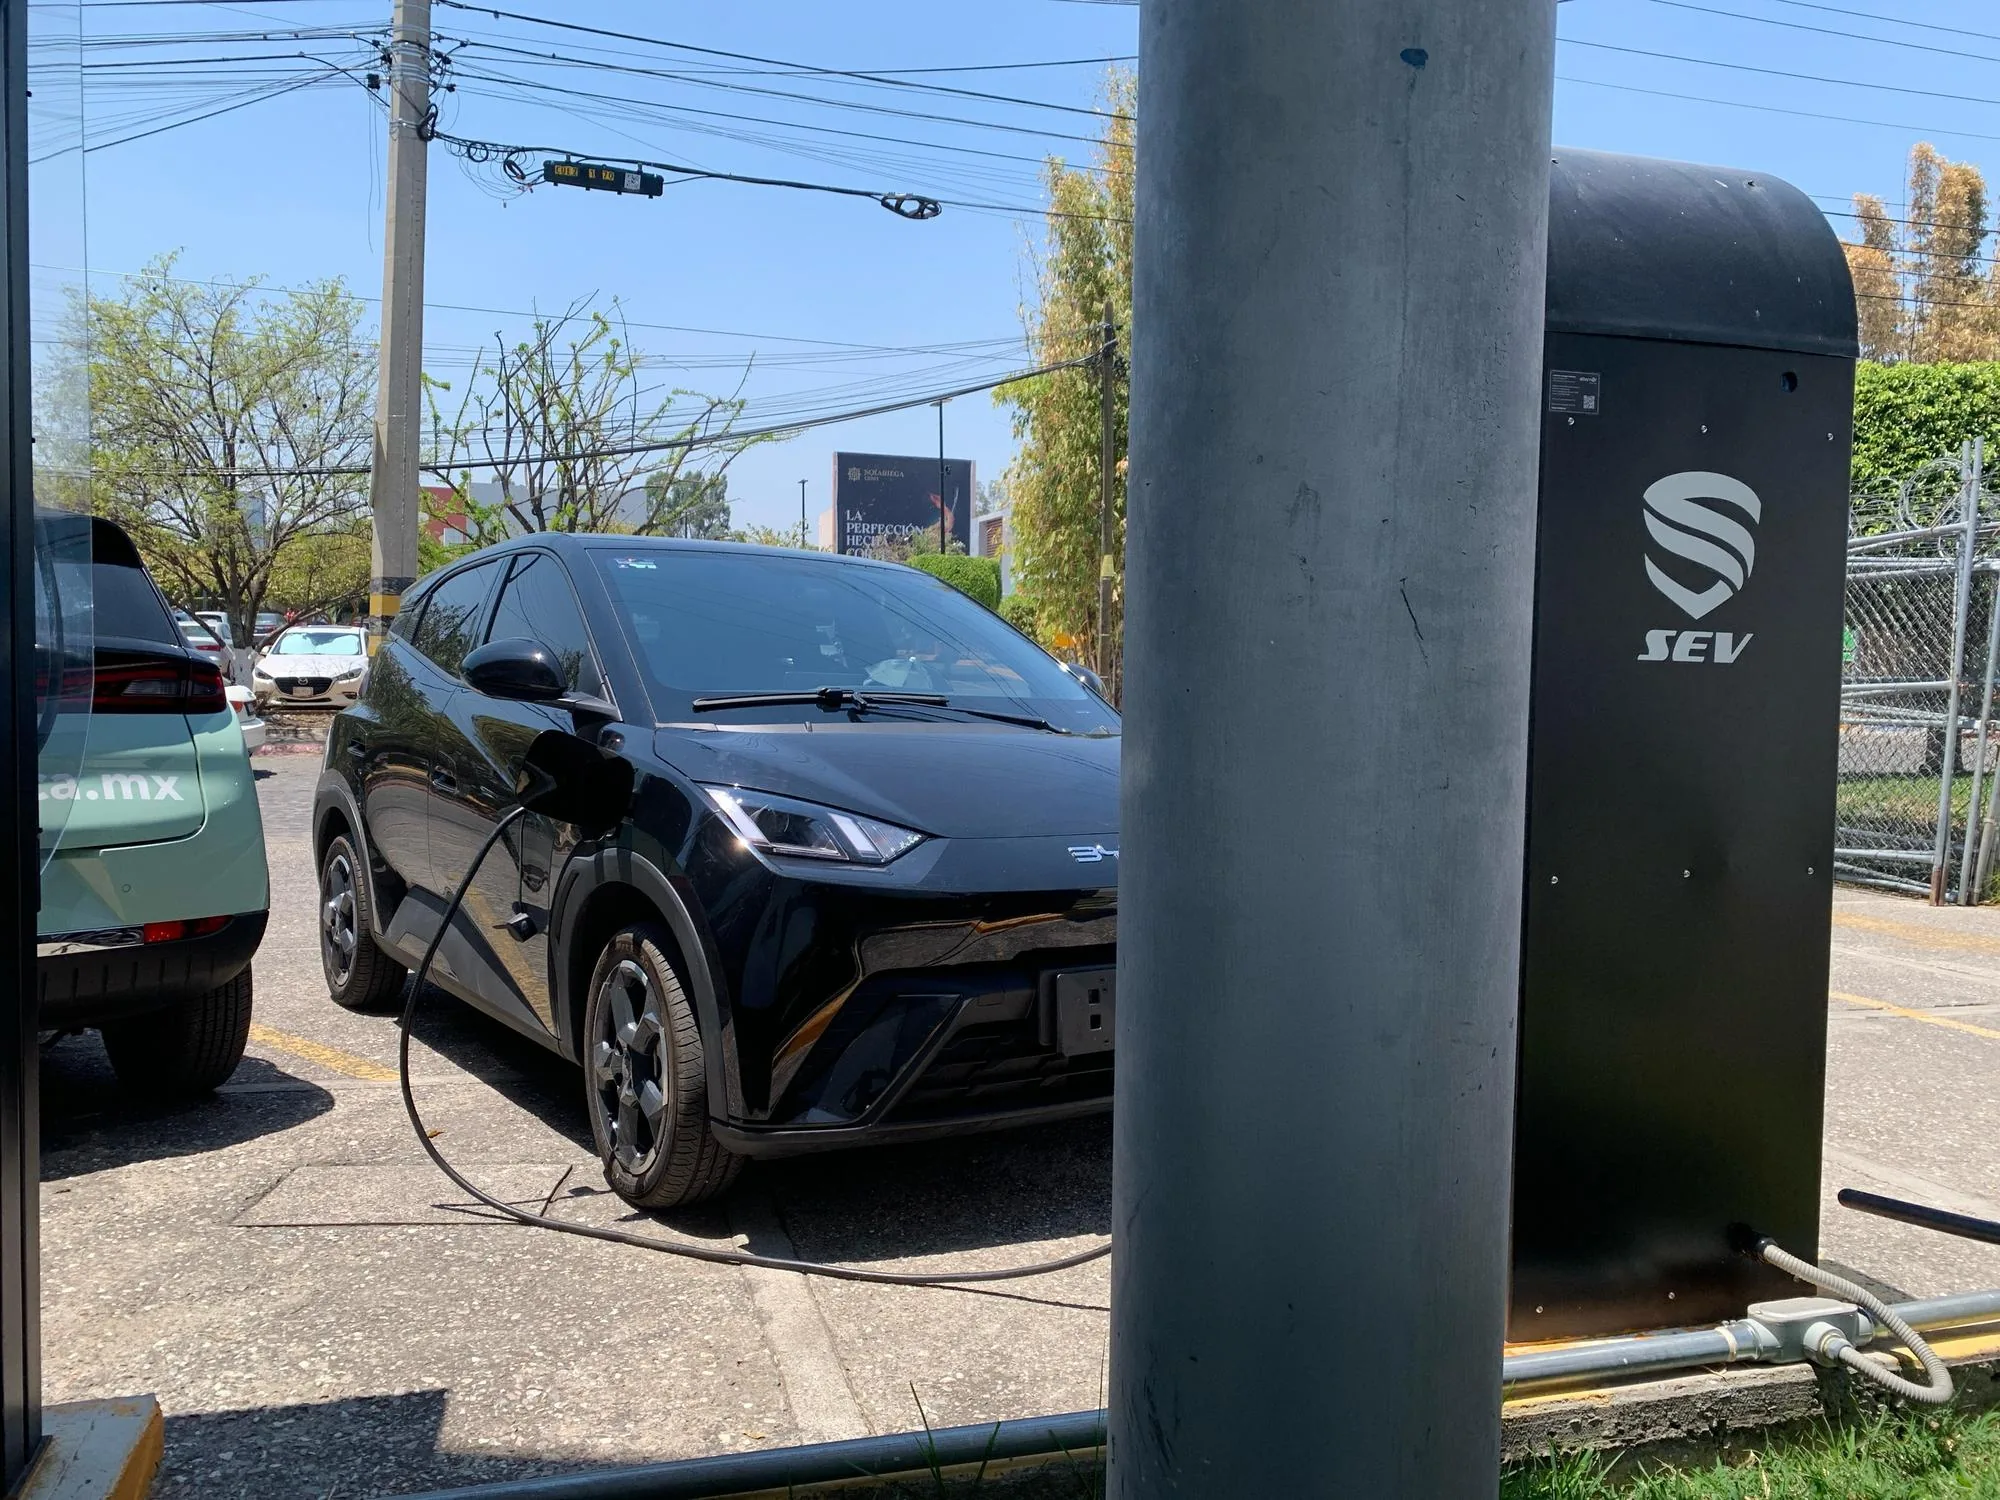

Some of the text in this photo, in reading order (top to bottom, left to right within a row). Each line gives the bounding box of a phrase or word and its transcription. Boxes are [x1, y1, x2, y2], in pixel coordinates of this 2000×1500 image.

[846, 509, 862, 521] LA
[846, 522, 924, 536] PERFECCIÓN
[1637, 629, 1755, 664] SEV
